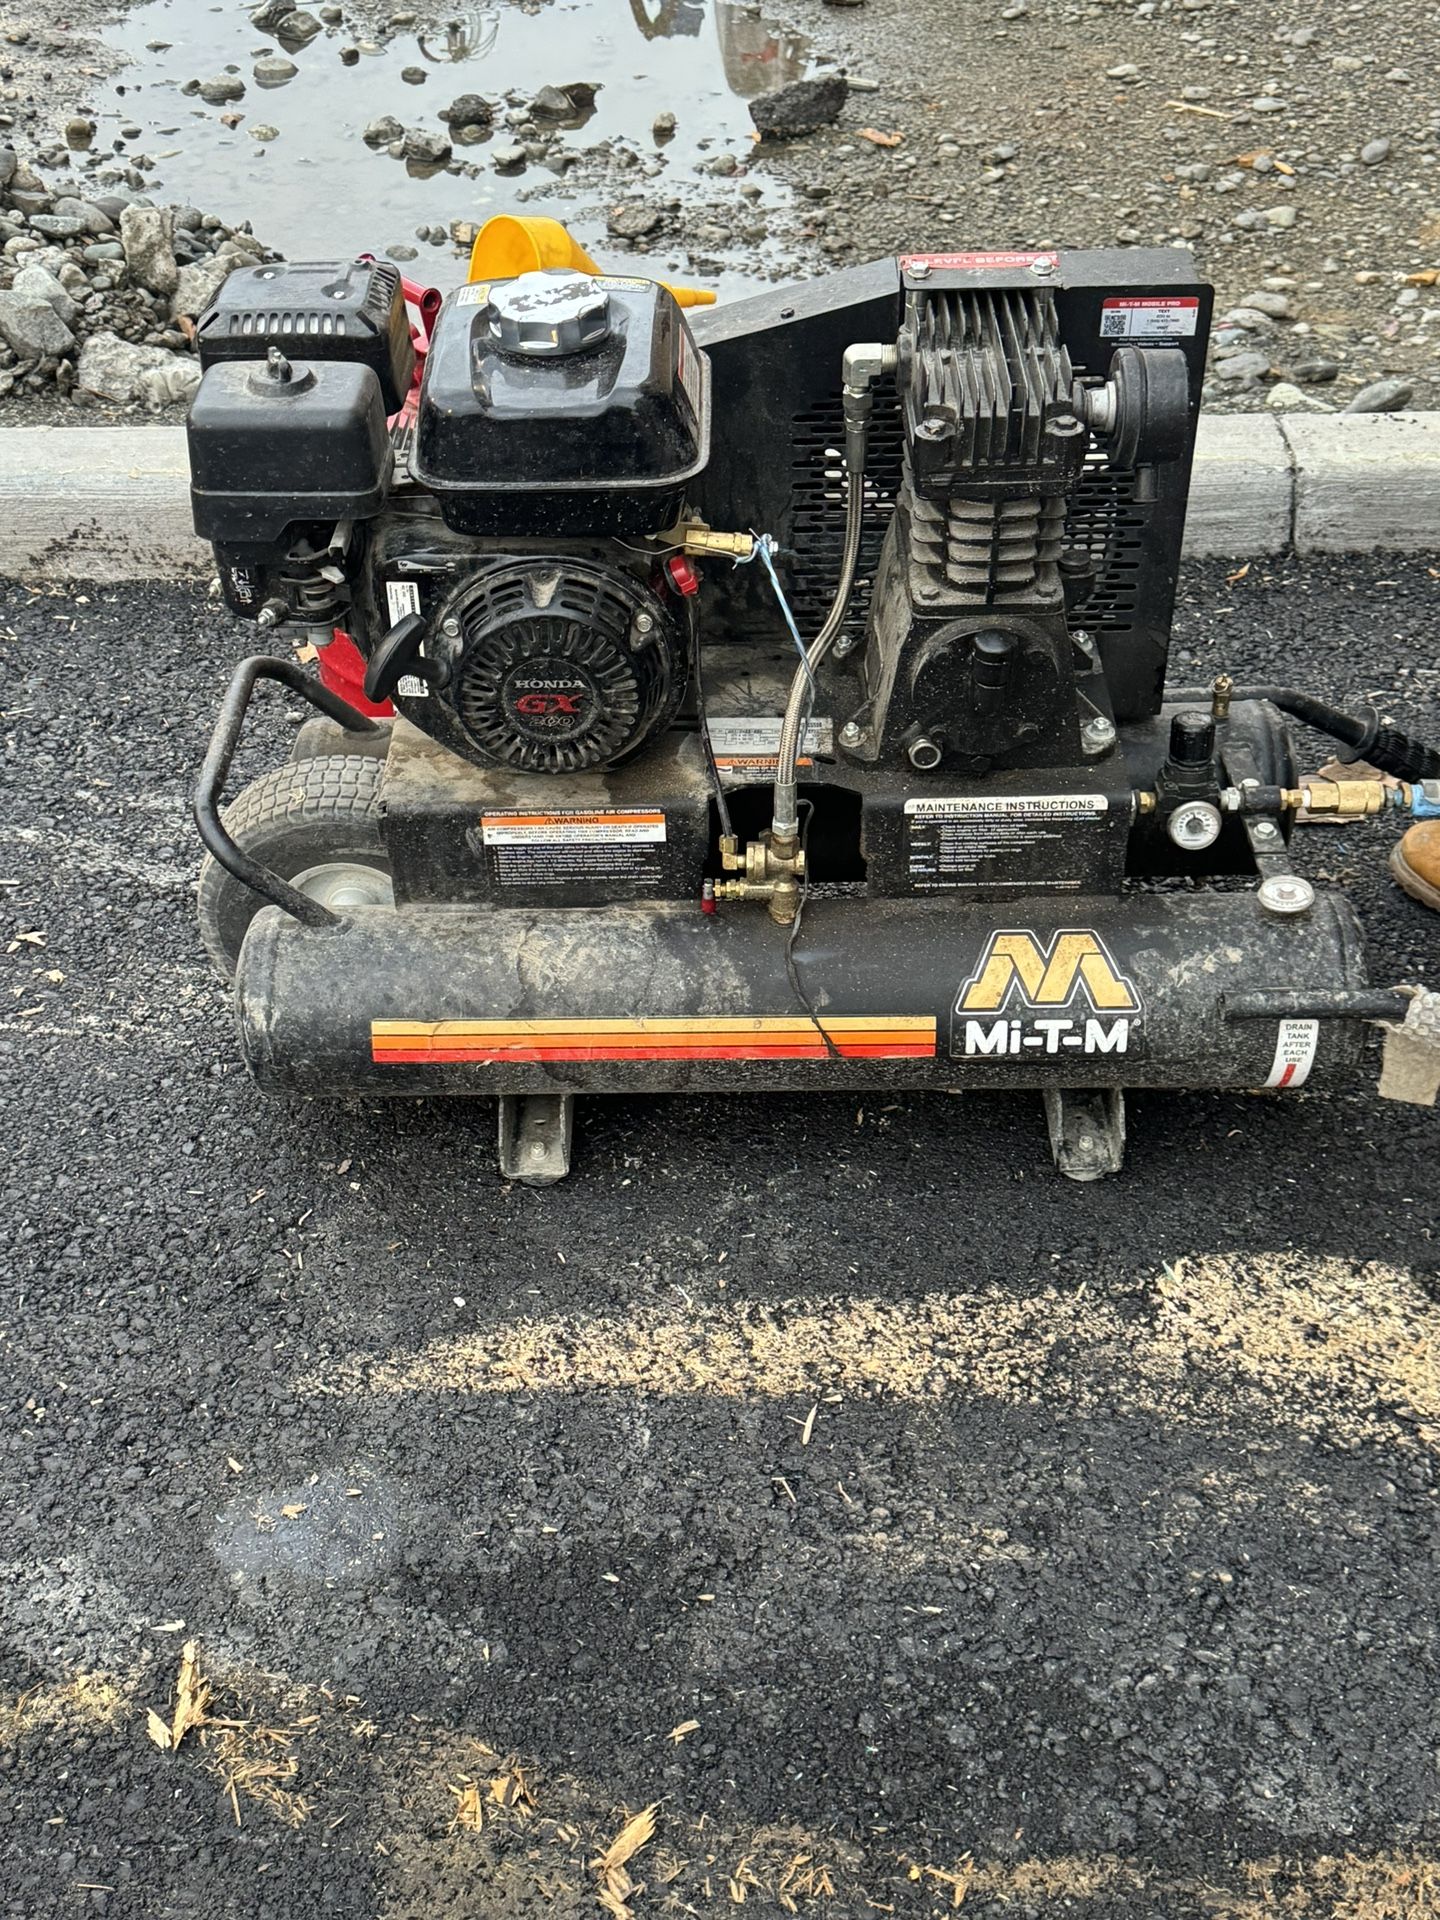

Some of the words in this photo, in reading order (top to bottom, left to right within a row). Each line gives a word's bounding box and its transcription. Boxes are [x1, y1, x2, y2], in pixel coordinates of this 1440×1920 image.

[514, 680, 587, 689] HONDA
[516, 694, 584, 714] GX
[529, 716, 576, 727] 200
[916, 802, 1001, 812] MAINTENANCE
[1006, 800, 1095, 810] INSTRUCTIONS
[554, 817, 599, 825] WARNING
[965, 1018, 1129, 1054] Mi-T-M
[1287, 1032, 1310, 1040] TANK
